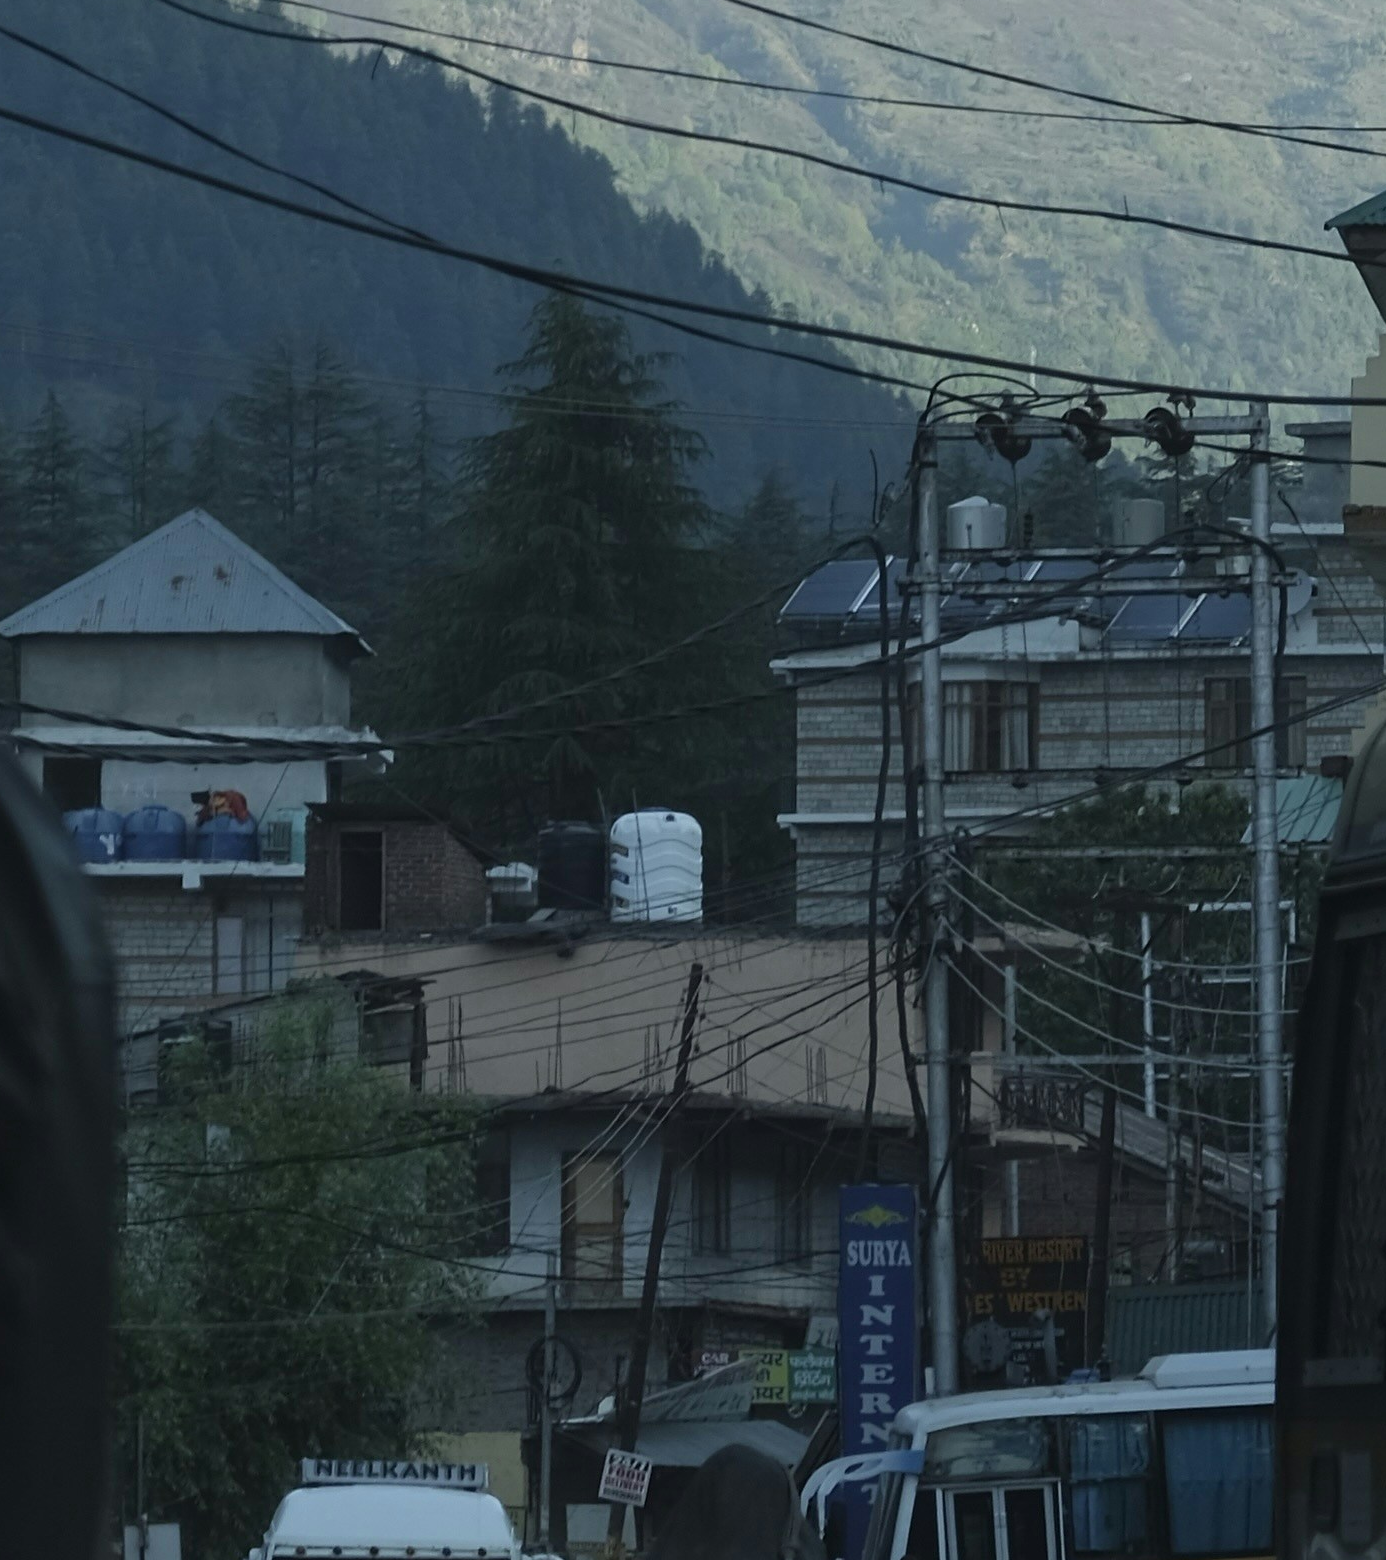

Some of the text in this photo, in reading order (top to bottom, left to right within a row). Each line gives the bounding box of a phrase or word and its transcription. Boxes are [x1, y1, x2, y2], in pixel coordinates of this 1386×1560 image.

[847, 1240, 912, 1267] SURYA
[1028, 1238, 1084, 1263] RESORT
[1000, 1267, 1031, 1288] BY
[314, 1459, 478, 1481] NEELKANTH
